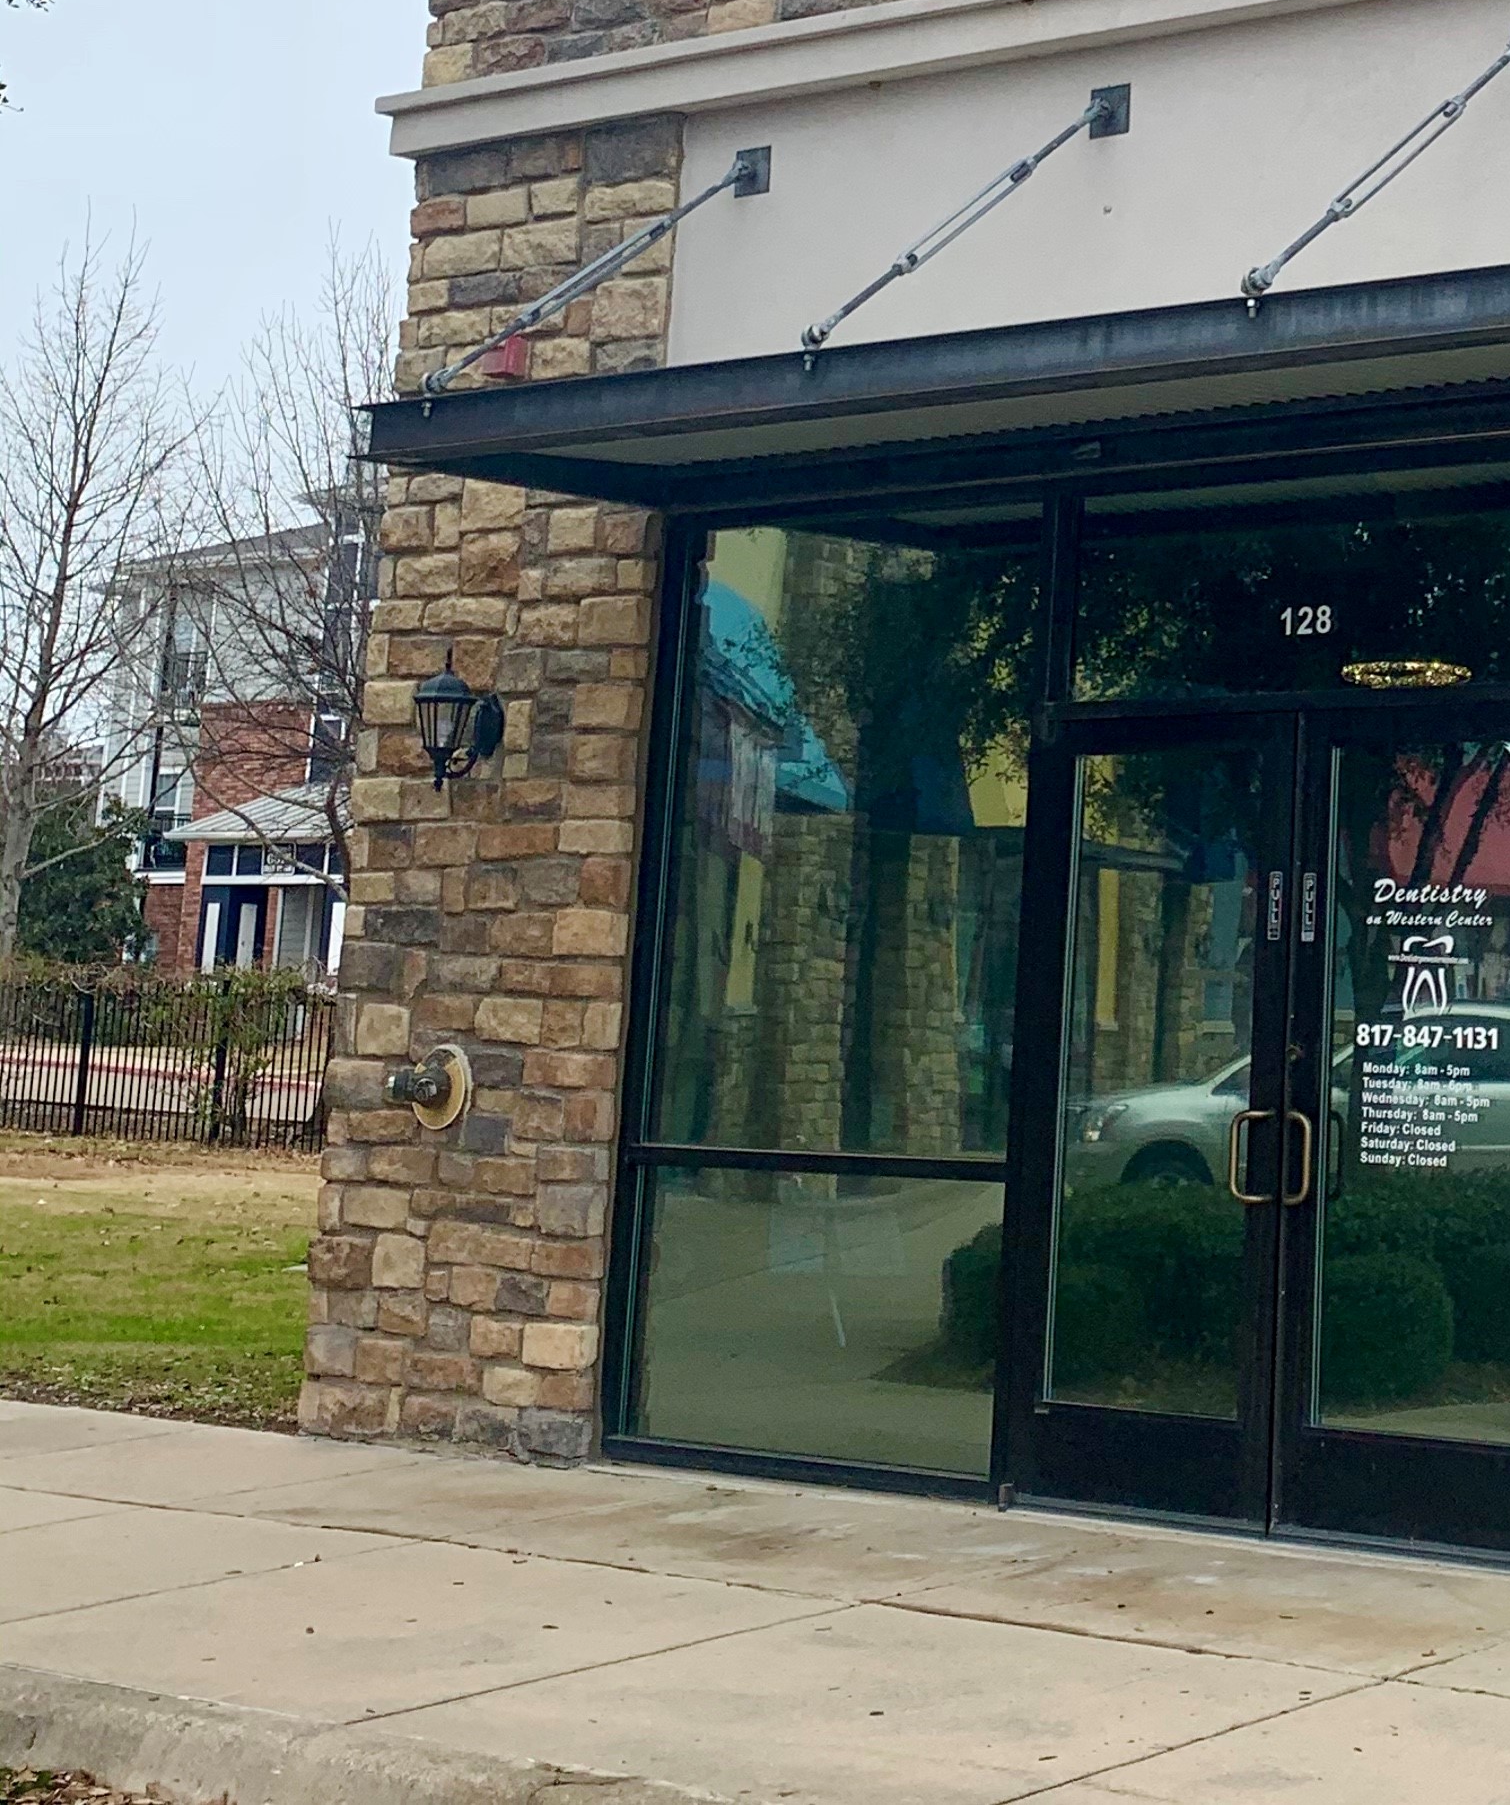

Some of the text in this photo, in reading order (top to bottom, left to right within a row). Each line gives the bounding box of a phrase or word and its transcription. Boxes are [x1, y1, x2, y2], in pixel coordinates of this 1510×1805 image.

[1280, 605, 1332, 636] 128
[1271, 877, 1280, 924] PULL
[1305, 879, 1314, 925] PULL
[1374, 878, 1487, 909] Dentistry
[1366, 909, 1493, 928] on Western Center
[1356, 1023, 1499, 1050] 817-847-1131
[1362, 1062, 1410, 1077] Monday:
[1414, 1063, 1438, 1075] 8am
[1446, 1064, 1470, 1078] 5pm
[1361, 1092, 1429, 1107] Wednesday:
[1434, 1094, 1457, 1106] 8am
[1466, 1095, 1490, 1109] 5pm
[1361, 1107, 1417, 1122] Thursday:
[1422, 1109, 1445, 1121] 8am
[1454, 1110, 1478, 1124] 5pm
[1361, 1122, 1441, 1136] Friday: Closed
[1360, 1136, 1456, 1152] Saturday: Closed
[1360, 1152, 1447, 1167] Sunday: Closed
